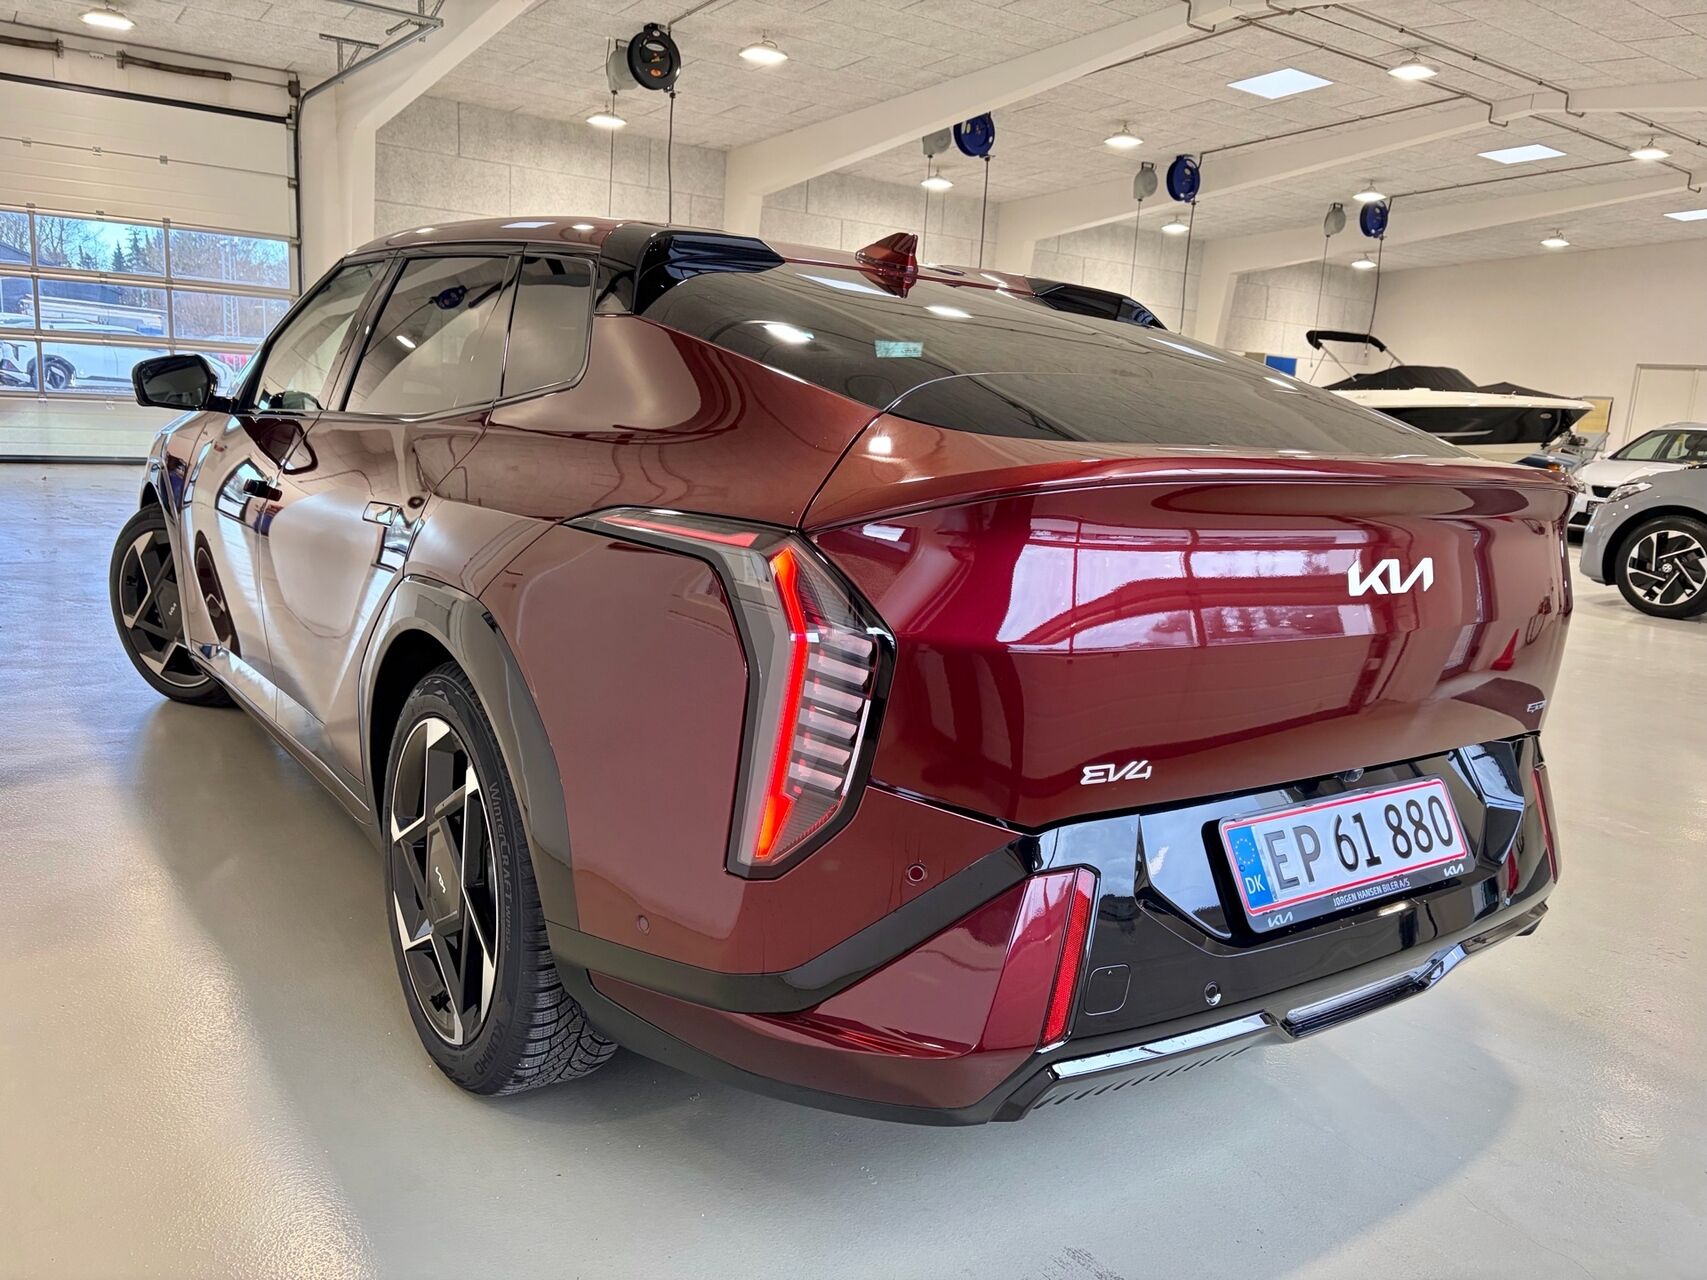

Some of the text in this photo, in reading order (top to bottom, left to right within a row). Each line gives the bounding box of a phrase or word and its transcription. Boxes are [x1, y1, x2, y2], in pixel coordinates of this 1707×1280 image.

[1347, 557, 1434, 597] KIA
[1080, 760, 1152, 786] EV4
[1263, 795, 1453, 890] EP 61 880
[1245, 874, 1266, 895] DK
[1357, 885, 1383, 900] HANSEN
[1382, 881, 1399, 893] BILER
